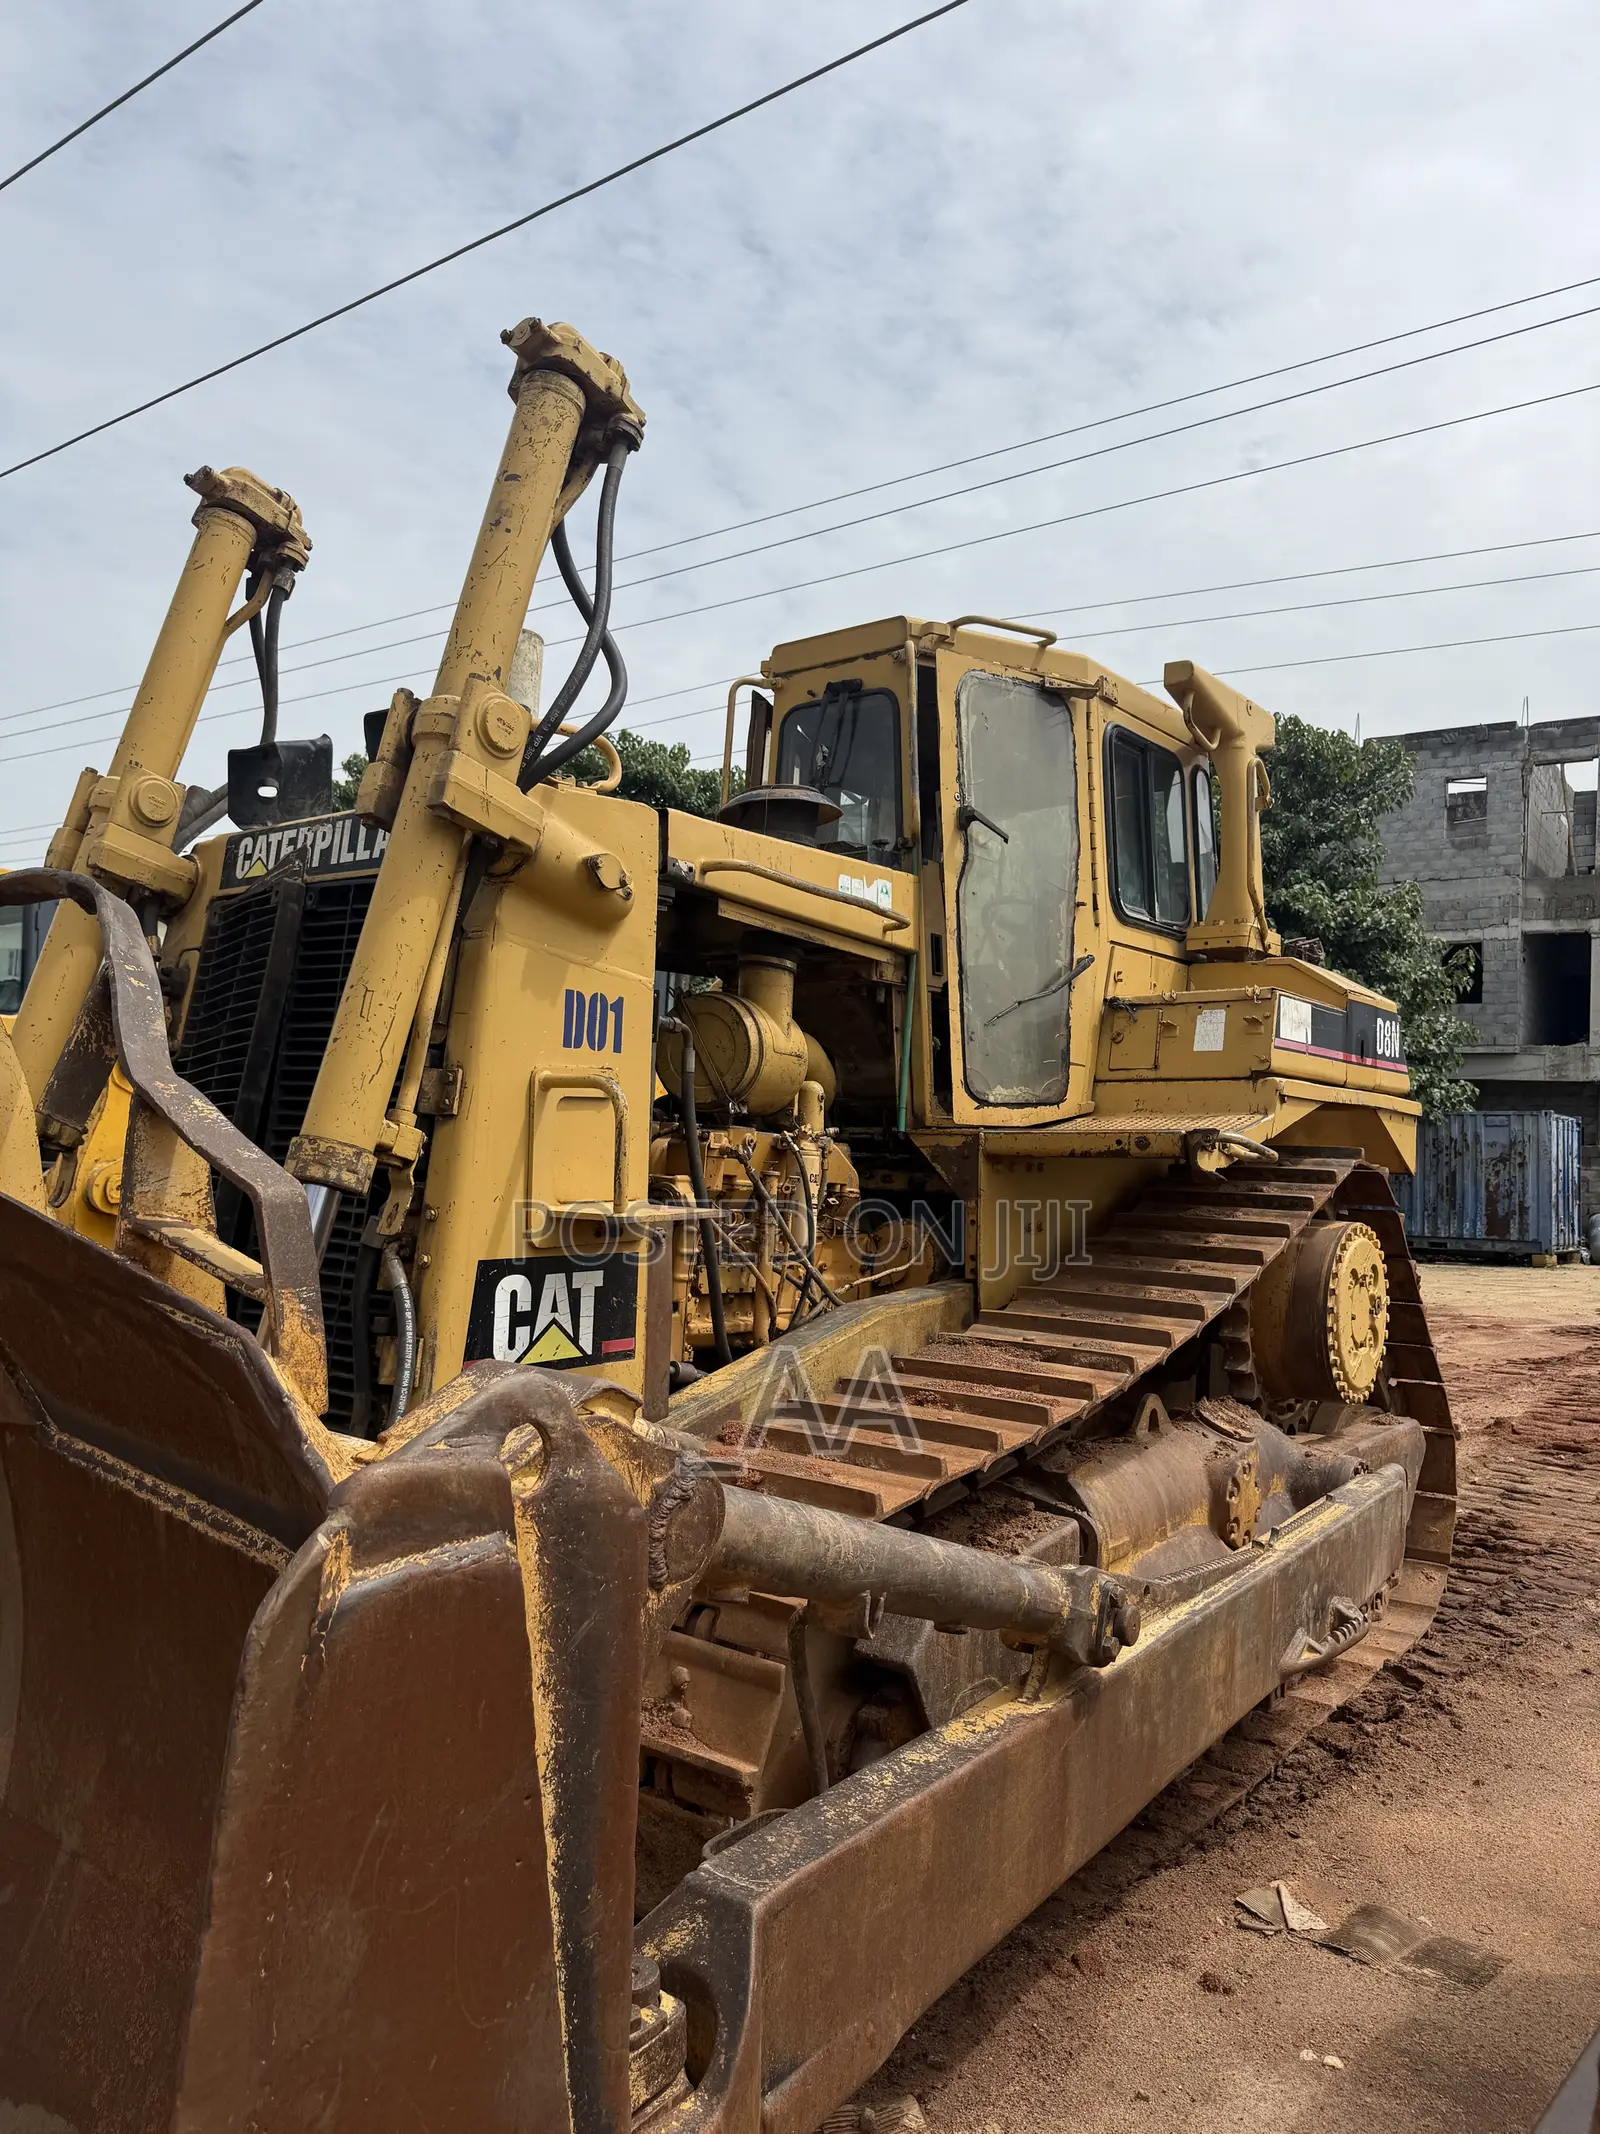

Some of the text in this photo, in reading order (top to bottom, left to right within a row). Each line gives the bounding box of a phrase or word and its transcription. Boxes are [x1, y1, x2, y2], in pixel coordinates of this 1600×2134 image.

[235, 818, 391, 880] CATERPILLA
[562, 988, 625, 1054] D01
[1376, 1017, 1400, 1059] D8N
[493, 1270, 605, 1363] CAT
